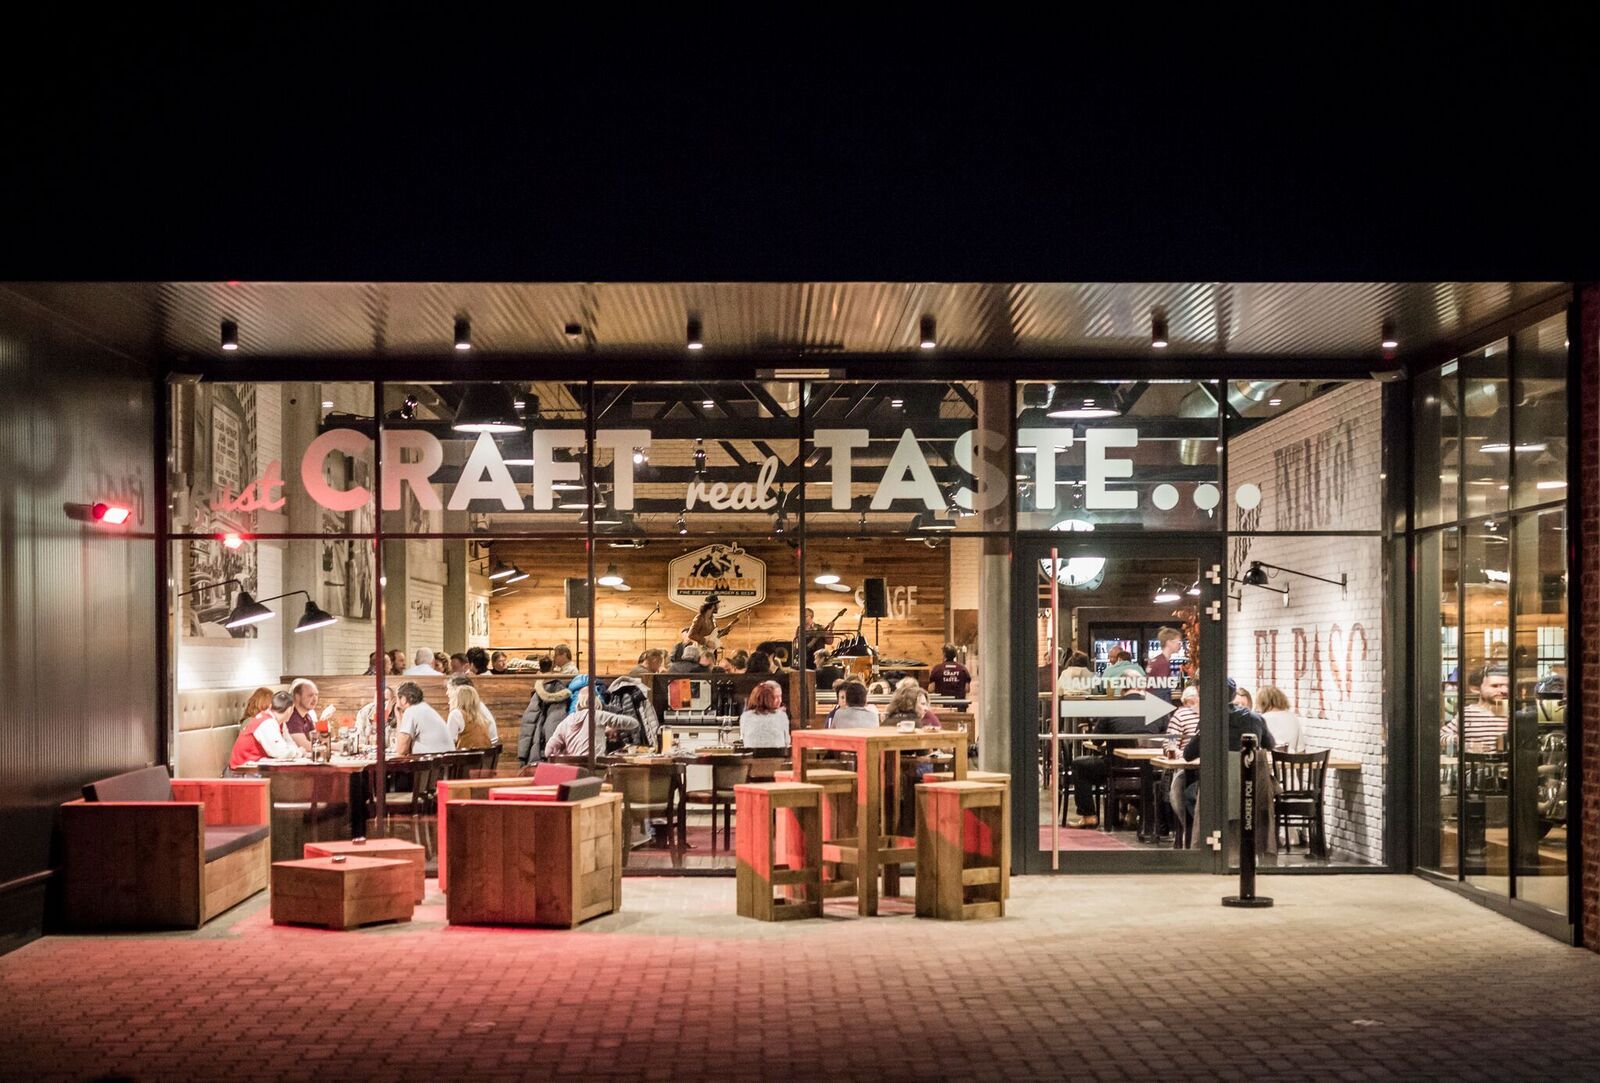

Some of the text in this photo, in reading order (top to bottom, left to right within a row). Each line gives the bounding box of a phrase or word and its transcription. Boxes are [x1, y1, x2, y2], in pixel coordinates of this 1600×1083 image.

[207, 459, 286, 513] ust
[302, 428, 652, 511] CRAFT
[686, 456, 778, 511] real
[855, 586, 918, 619] SAGE
